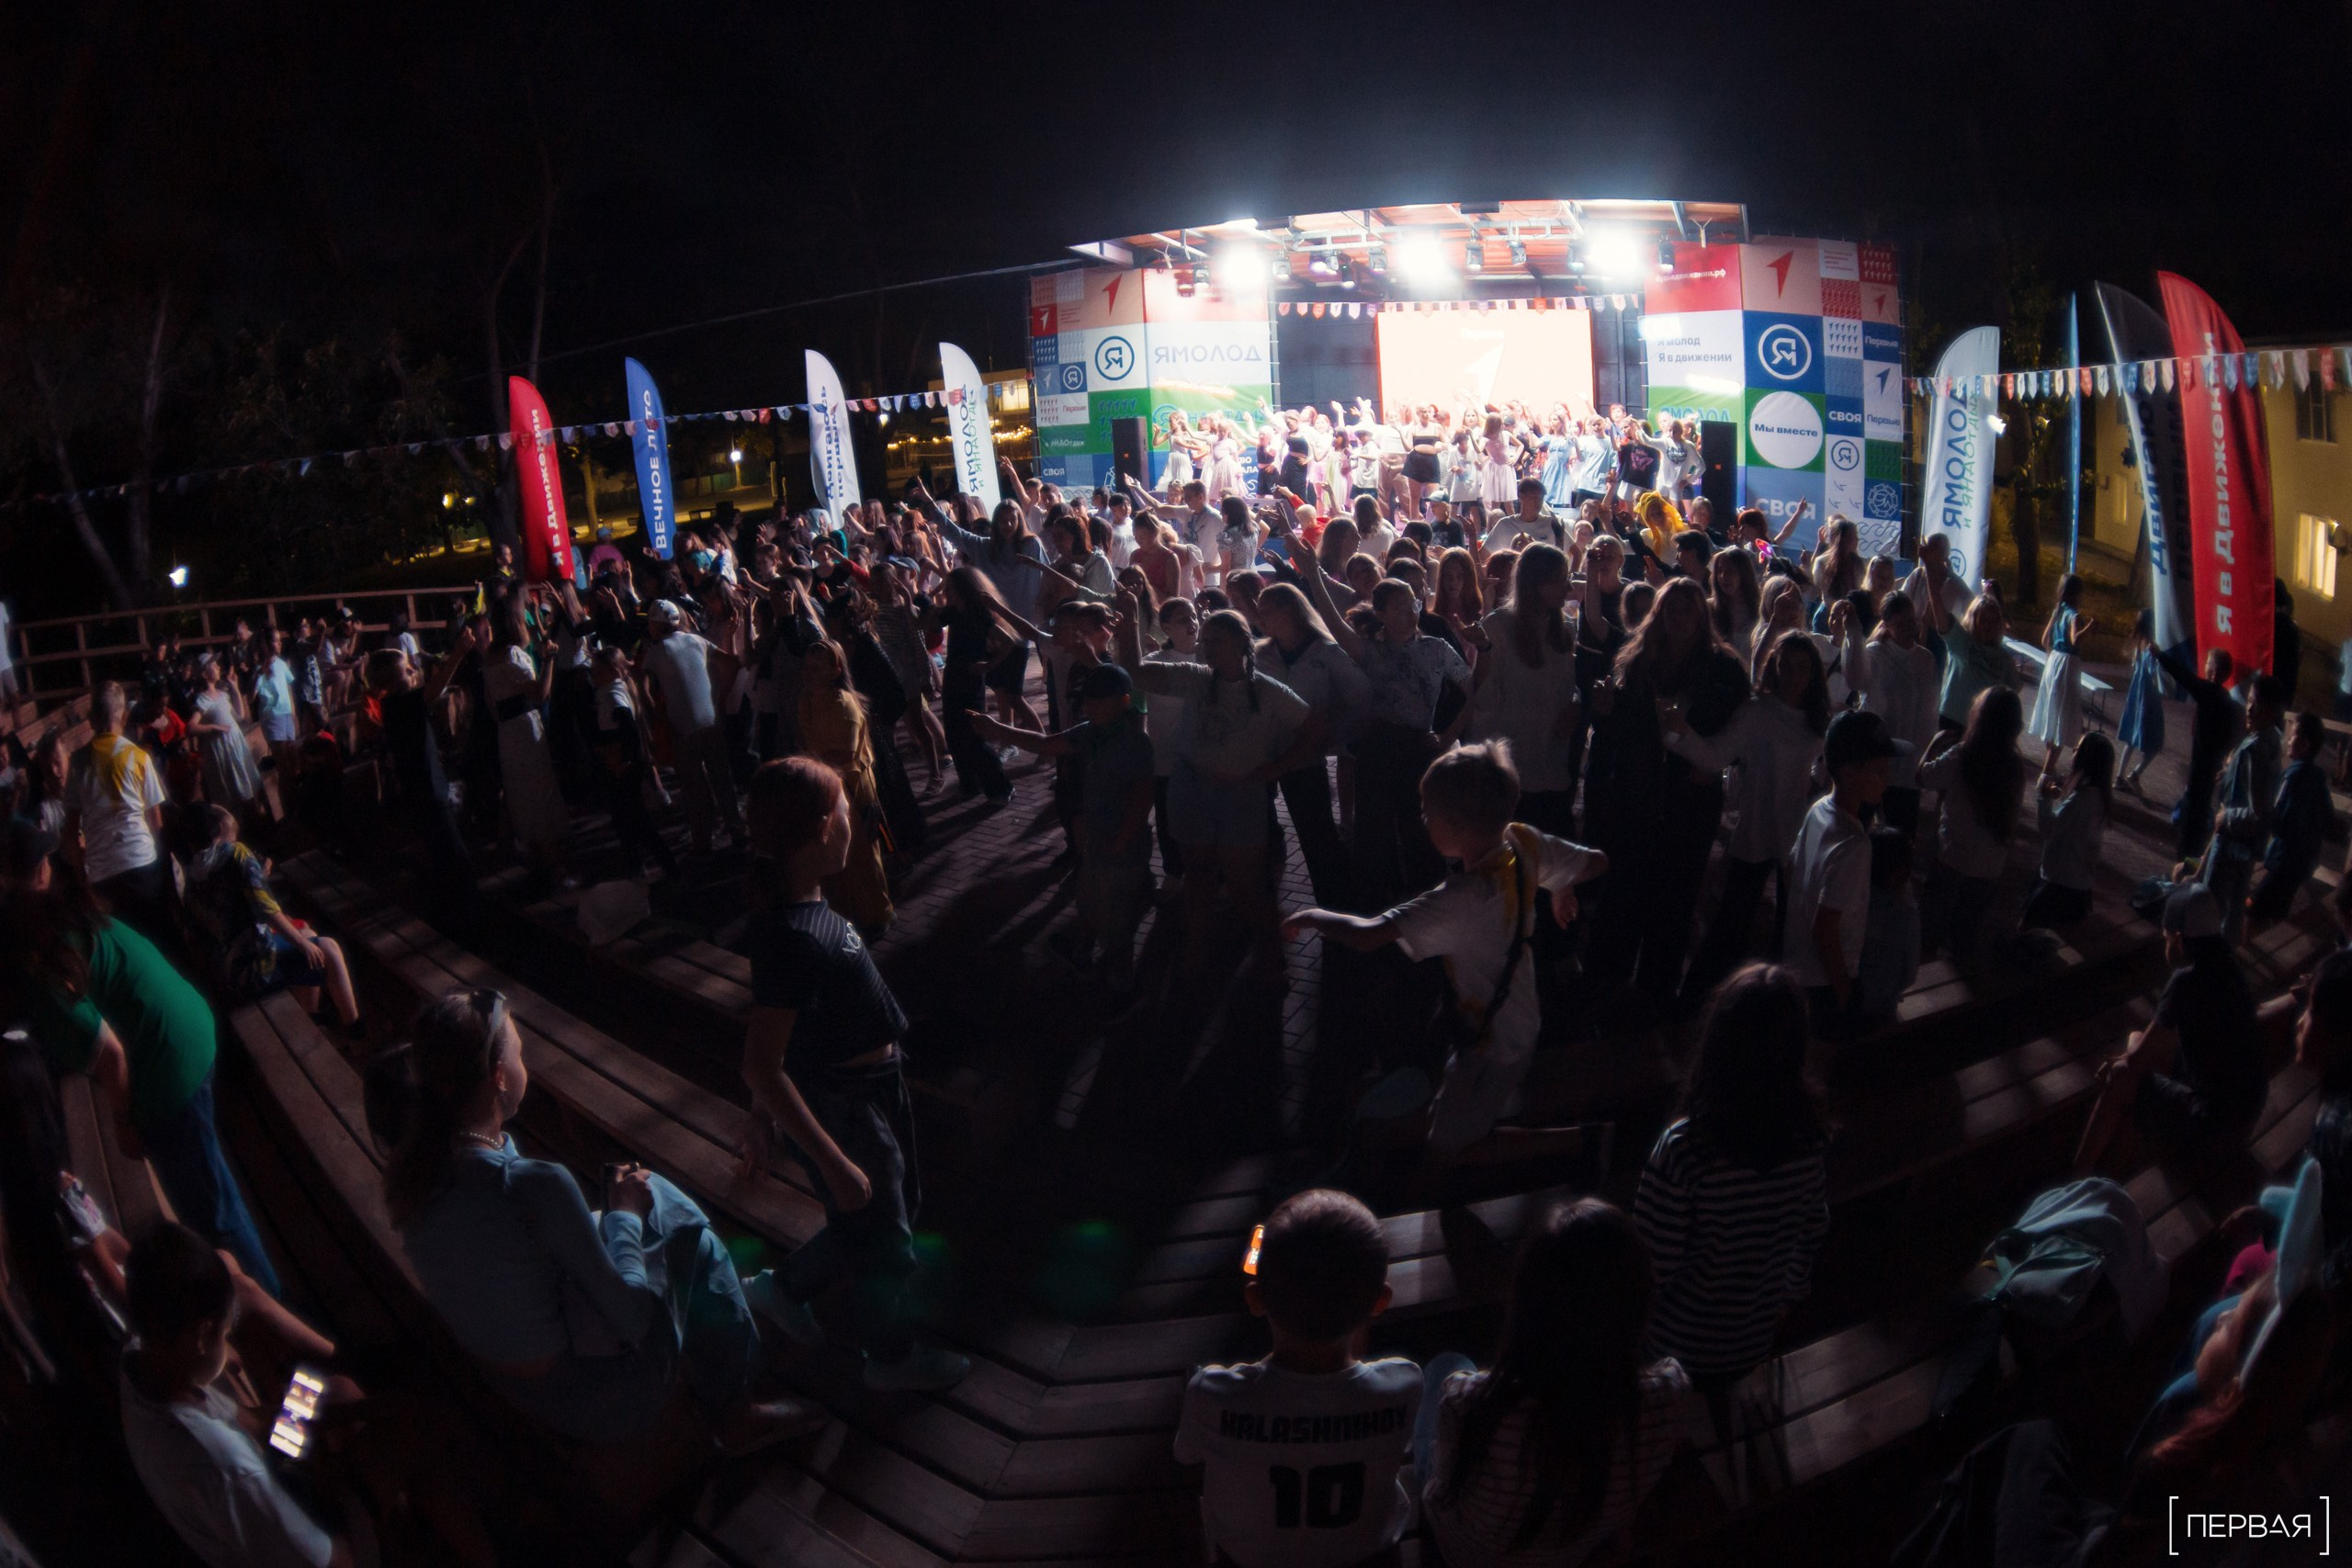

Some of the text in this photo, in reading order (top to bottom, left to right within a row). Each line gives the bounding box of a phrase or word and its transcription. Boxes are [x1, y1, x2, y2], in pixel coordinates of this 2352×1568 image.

[1658, 353, 1665, 362] Я
[1675, 354, 1732, 363] движении
[1828, 411, 1862, 423] СВОЯ
[1867, 414, 1901, 426] Первые
[1755, 423, 1818, 437] Мы вместе
[643, 389, 668, 549] ВЕЧНОЕ ЛТО
[1043, 468, 1065, 476] СВОЯ
[2220, 572, 2233, 596] в
[2216, 605, 2233, 636] Я
[1269, 1461, 1367, 1529] 10
